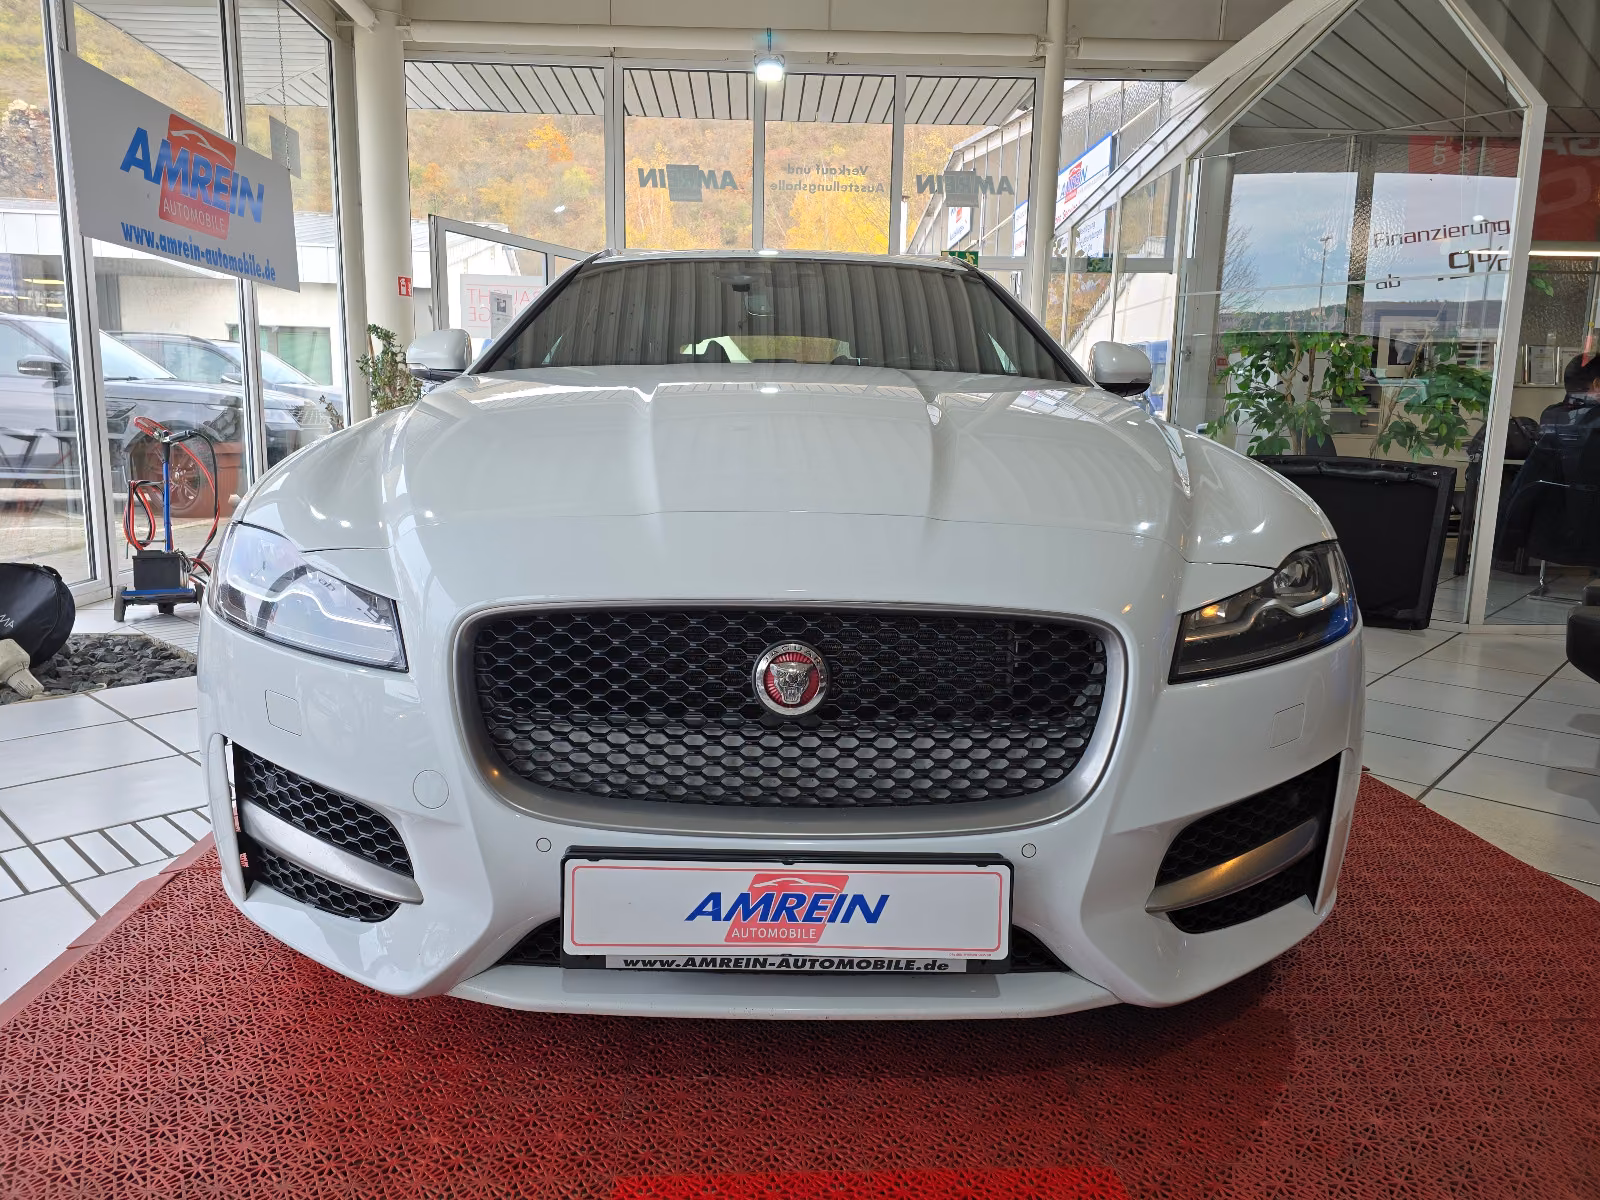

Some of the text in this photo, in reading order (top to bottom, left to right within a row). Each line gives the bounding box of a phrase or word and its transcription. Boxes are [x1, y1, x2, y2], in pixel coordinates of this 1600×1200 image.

[120, 127, 265, 223] AMREIN
[163, 199, 226, 233] AUTOMOBILE
[1374, 219, 1510, 248] Finanzierung
[120, 221, 277, 281] www.amrein-automobile.de
[1376, 273, 1400, 290] ab
[684, 891, 890, 924] AMREIN
[731, 927, 817, 939] AUTOMOBILE
[623, 956, 949, 972] www.AMREIN-AUTOMOBILE.de
